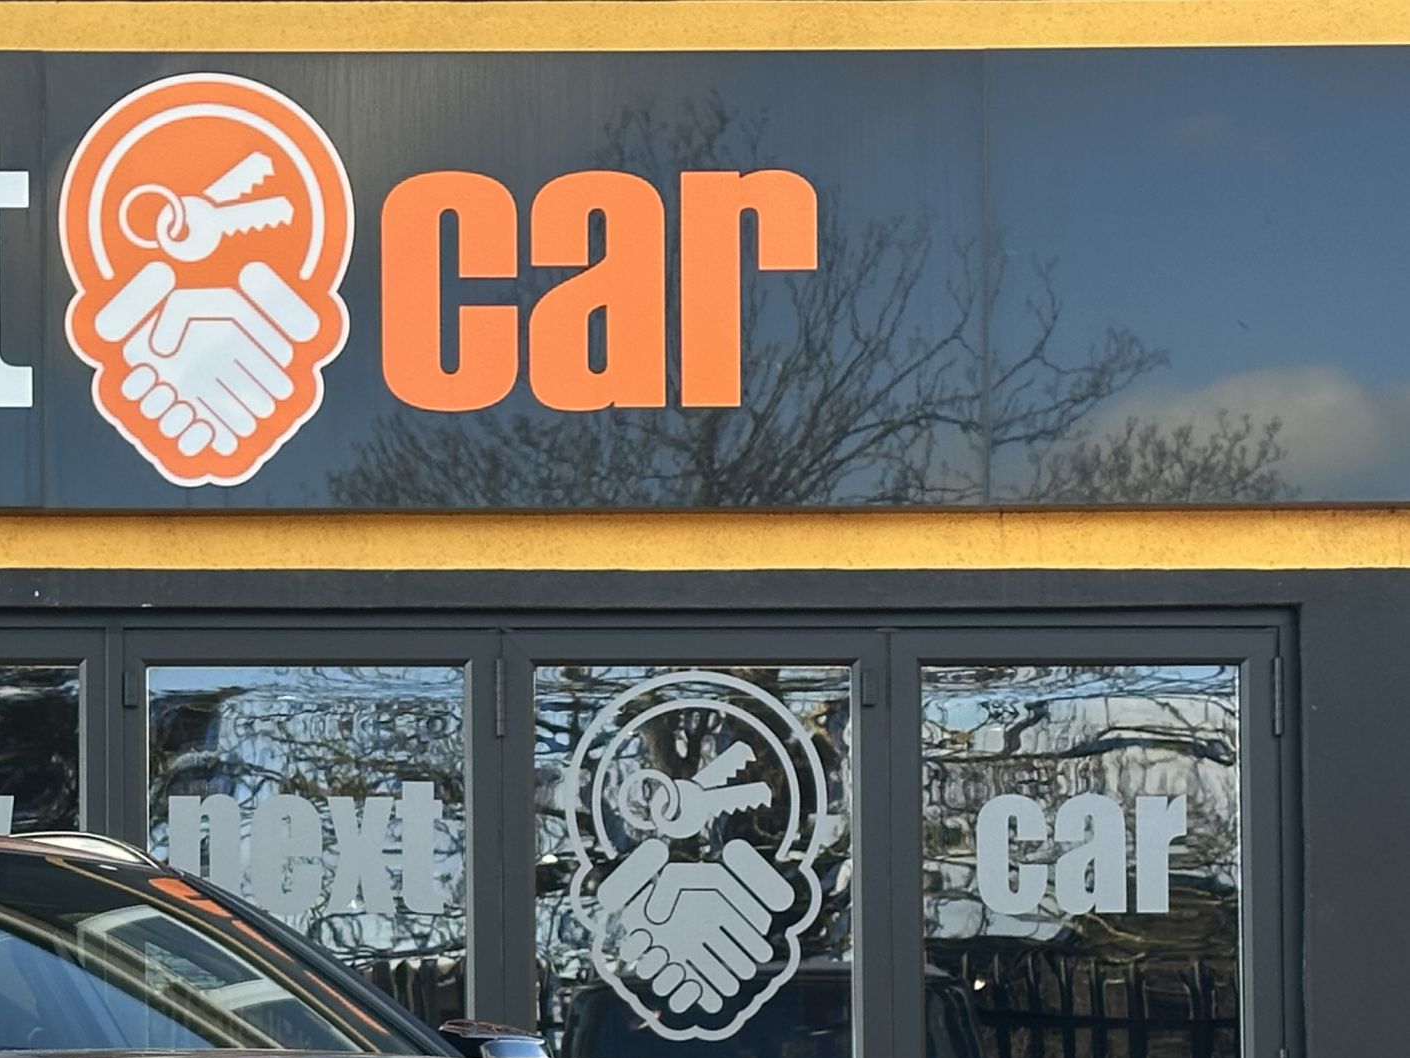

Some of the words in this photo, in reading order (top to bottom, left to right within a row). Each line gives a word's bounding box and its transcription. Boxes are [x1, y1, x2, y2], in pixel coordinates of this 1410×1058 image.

[380, 168, 818, 413] car
[168, 780, 446, 915] next
[976, 793, 1187, 915] car
